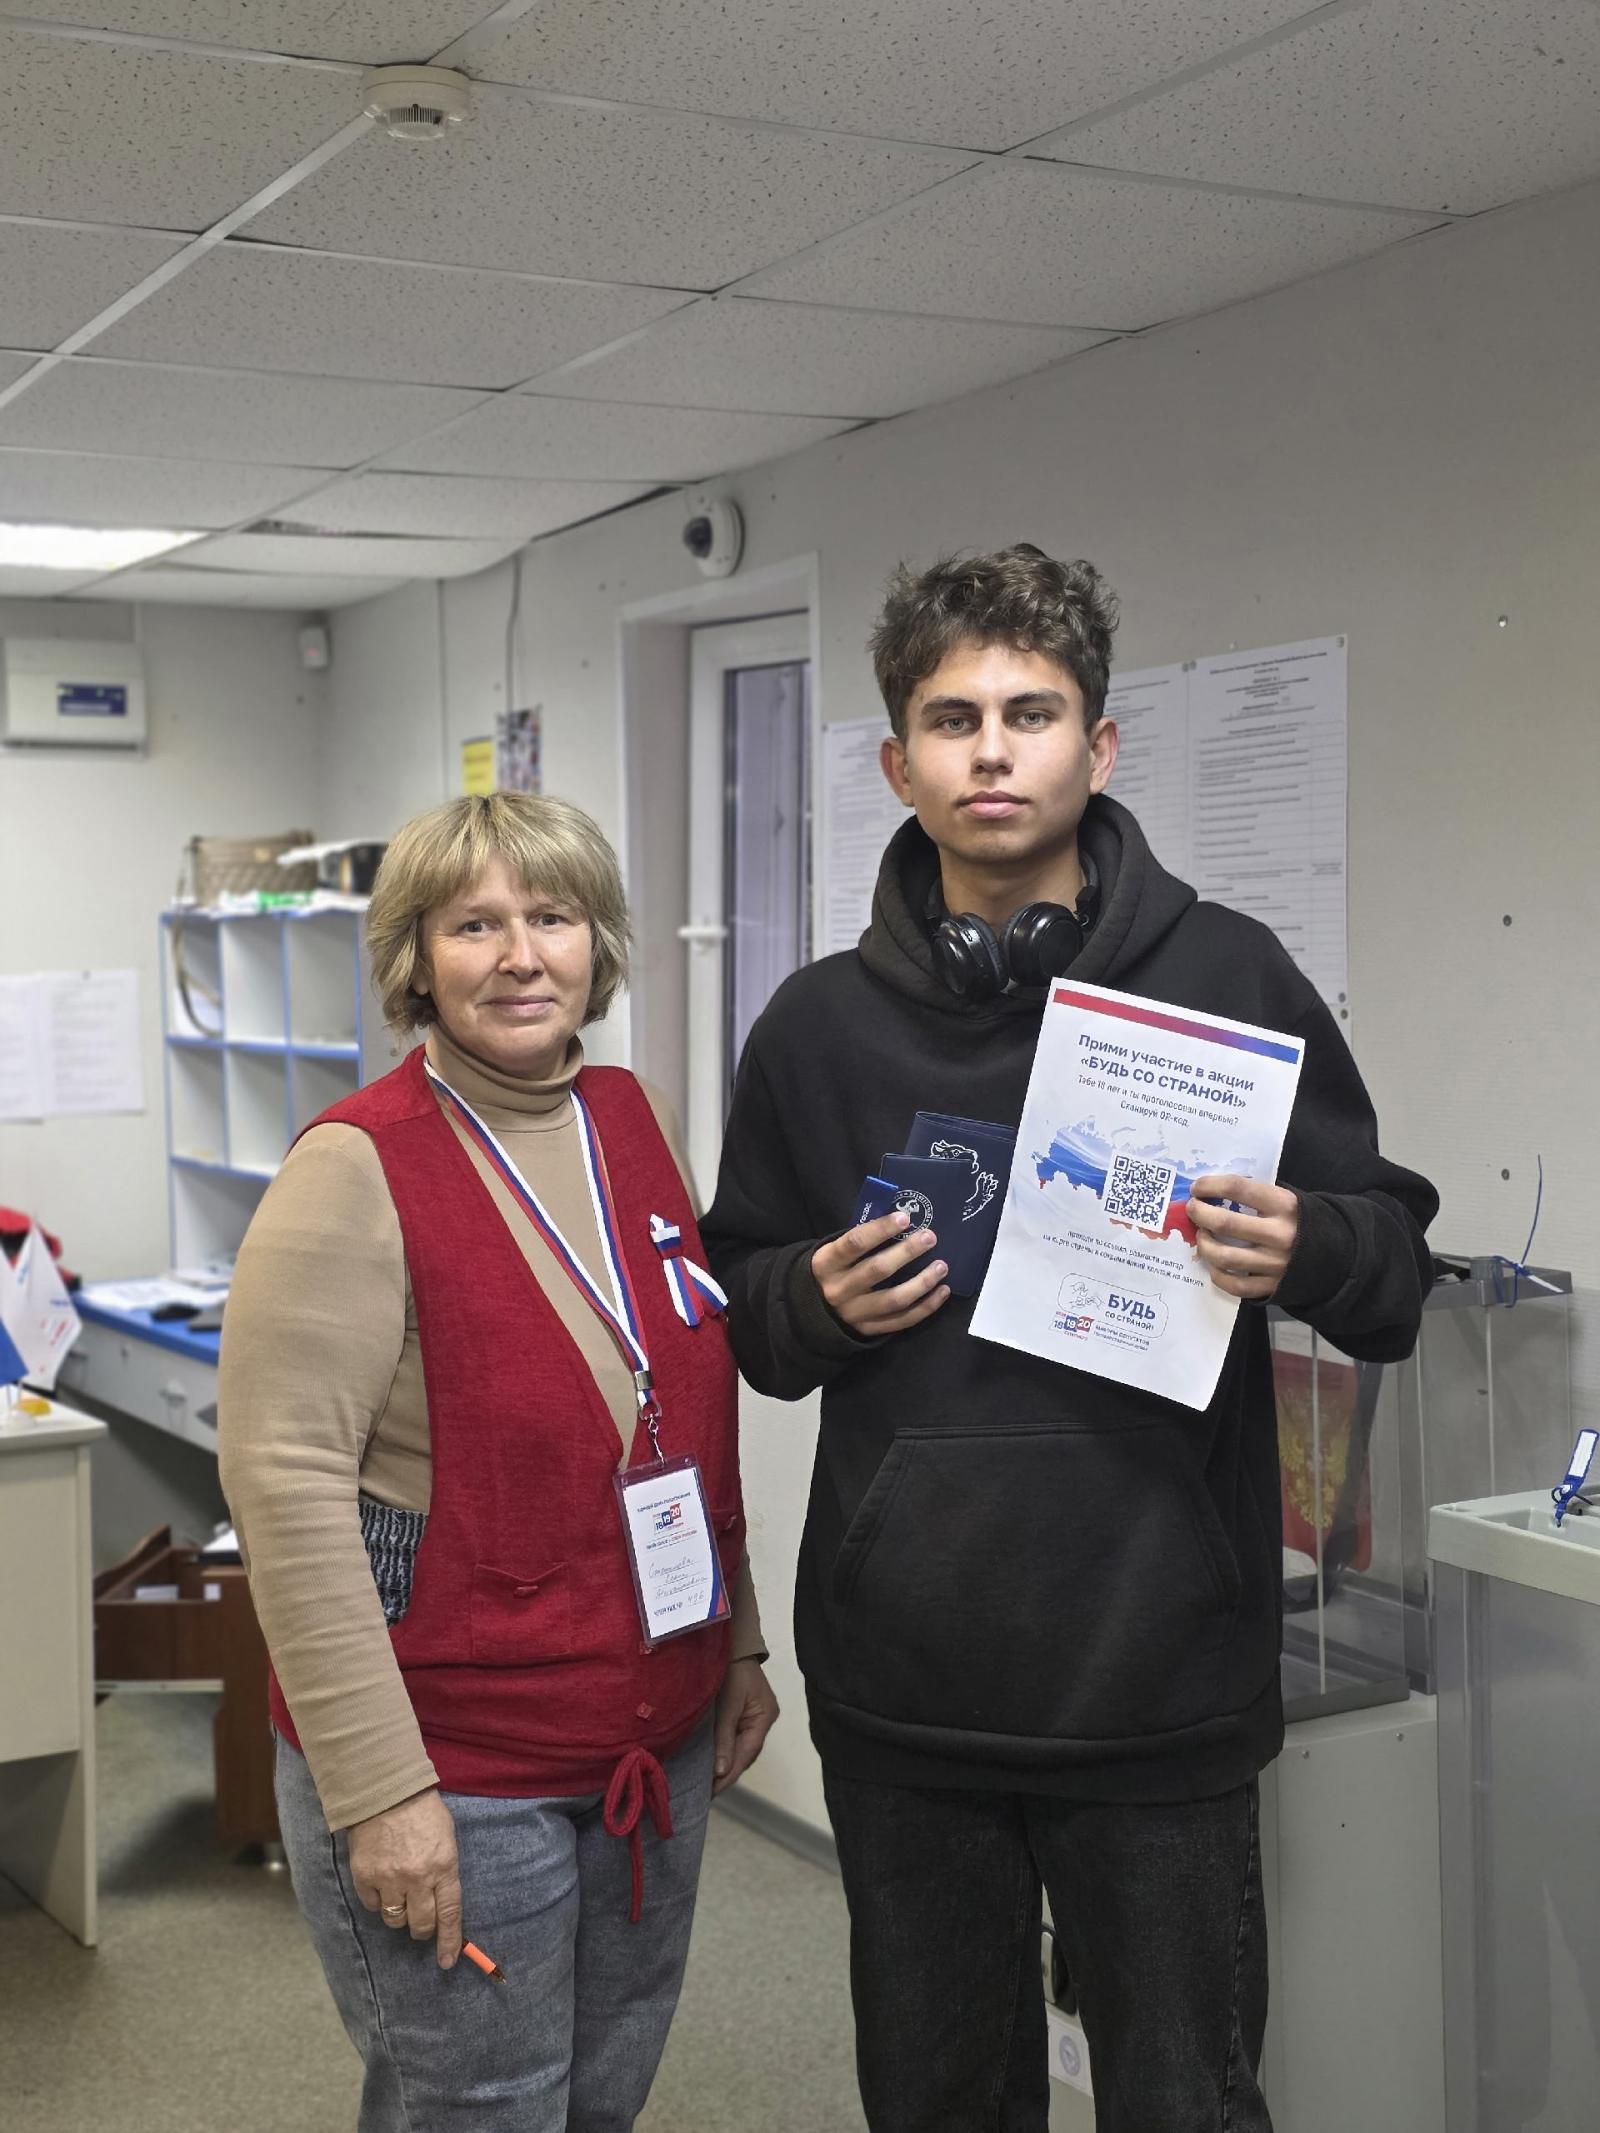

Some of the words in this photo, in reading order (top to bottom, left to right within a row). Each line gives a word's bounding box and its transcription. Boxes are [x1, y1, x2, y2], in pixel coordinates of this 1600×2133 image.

[1079, 1034, 1128, 1057] Прими
[1131, 1050, 1193, 1074] участие
[1195, 1067, 1205, 1078] в
[1208, 1071, 1254, 1091] акции
[1080, 1056, 1129, 1077] «БУДЬ
[1133, 1068, 1154, 1084] СО
[1159, 1075, 1247, 1108] СТРАНОЙ!»
[1108, 1293, 1156, 1320] БУДЬ
[1054, 1320, 1064, 1330] 18
[1066, 1316, 1077, 1329] 19
[1077, 1318, 1091, 1329] 20
[1104, 1311, 1116, 1319] СО
[1116, 1314, 1154, 1331] СТРАНОЙ!
[655, 1521, 664, 1531] 18
[663, 1513, 671, 1524] 19
[671, 1507, 680, 1517] 20
